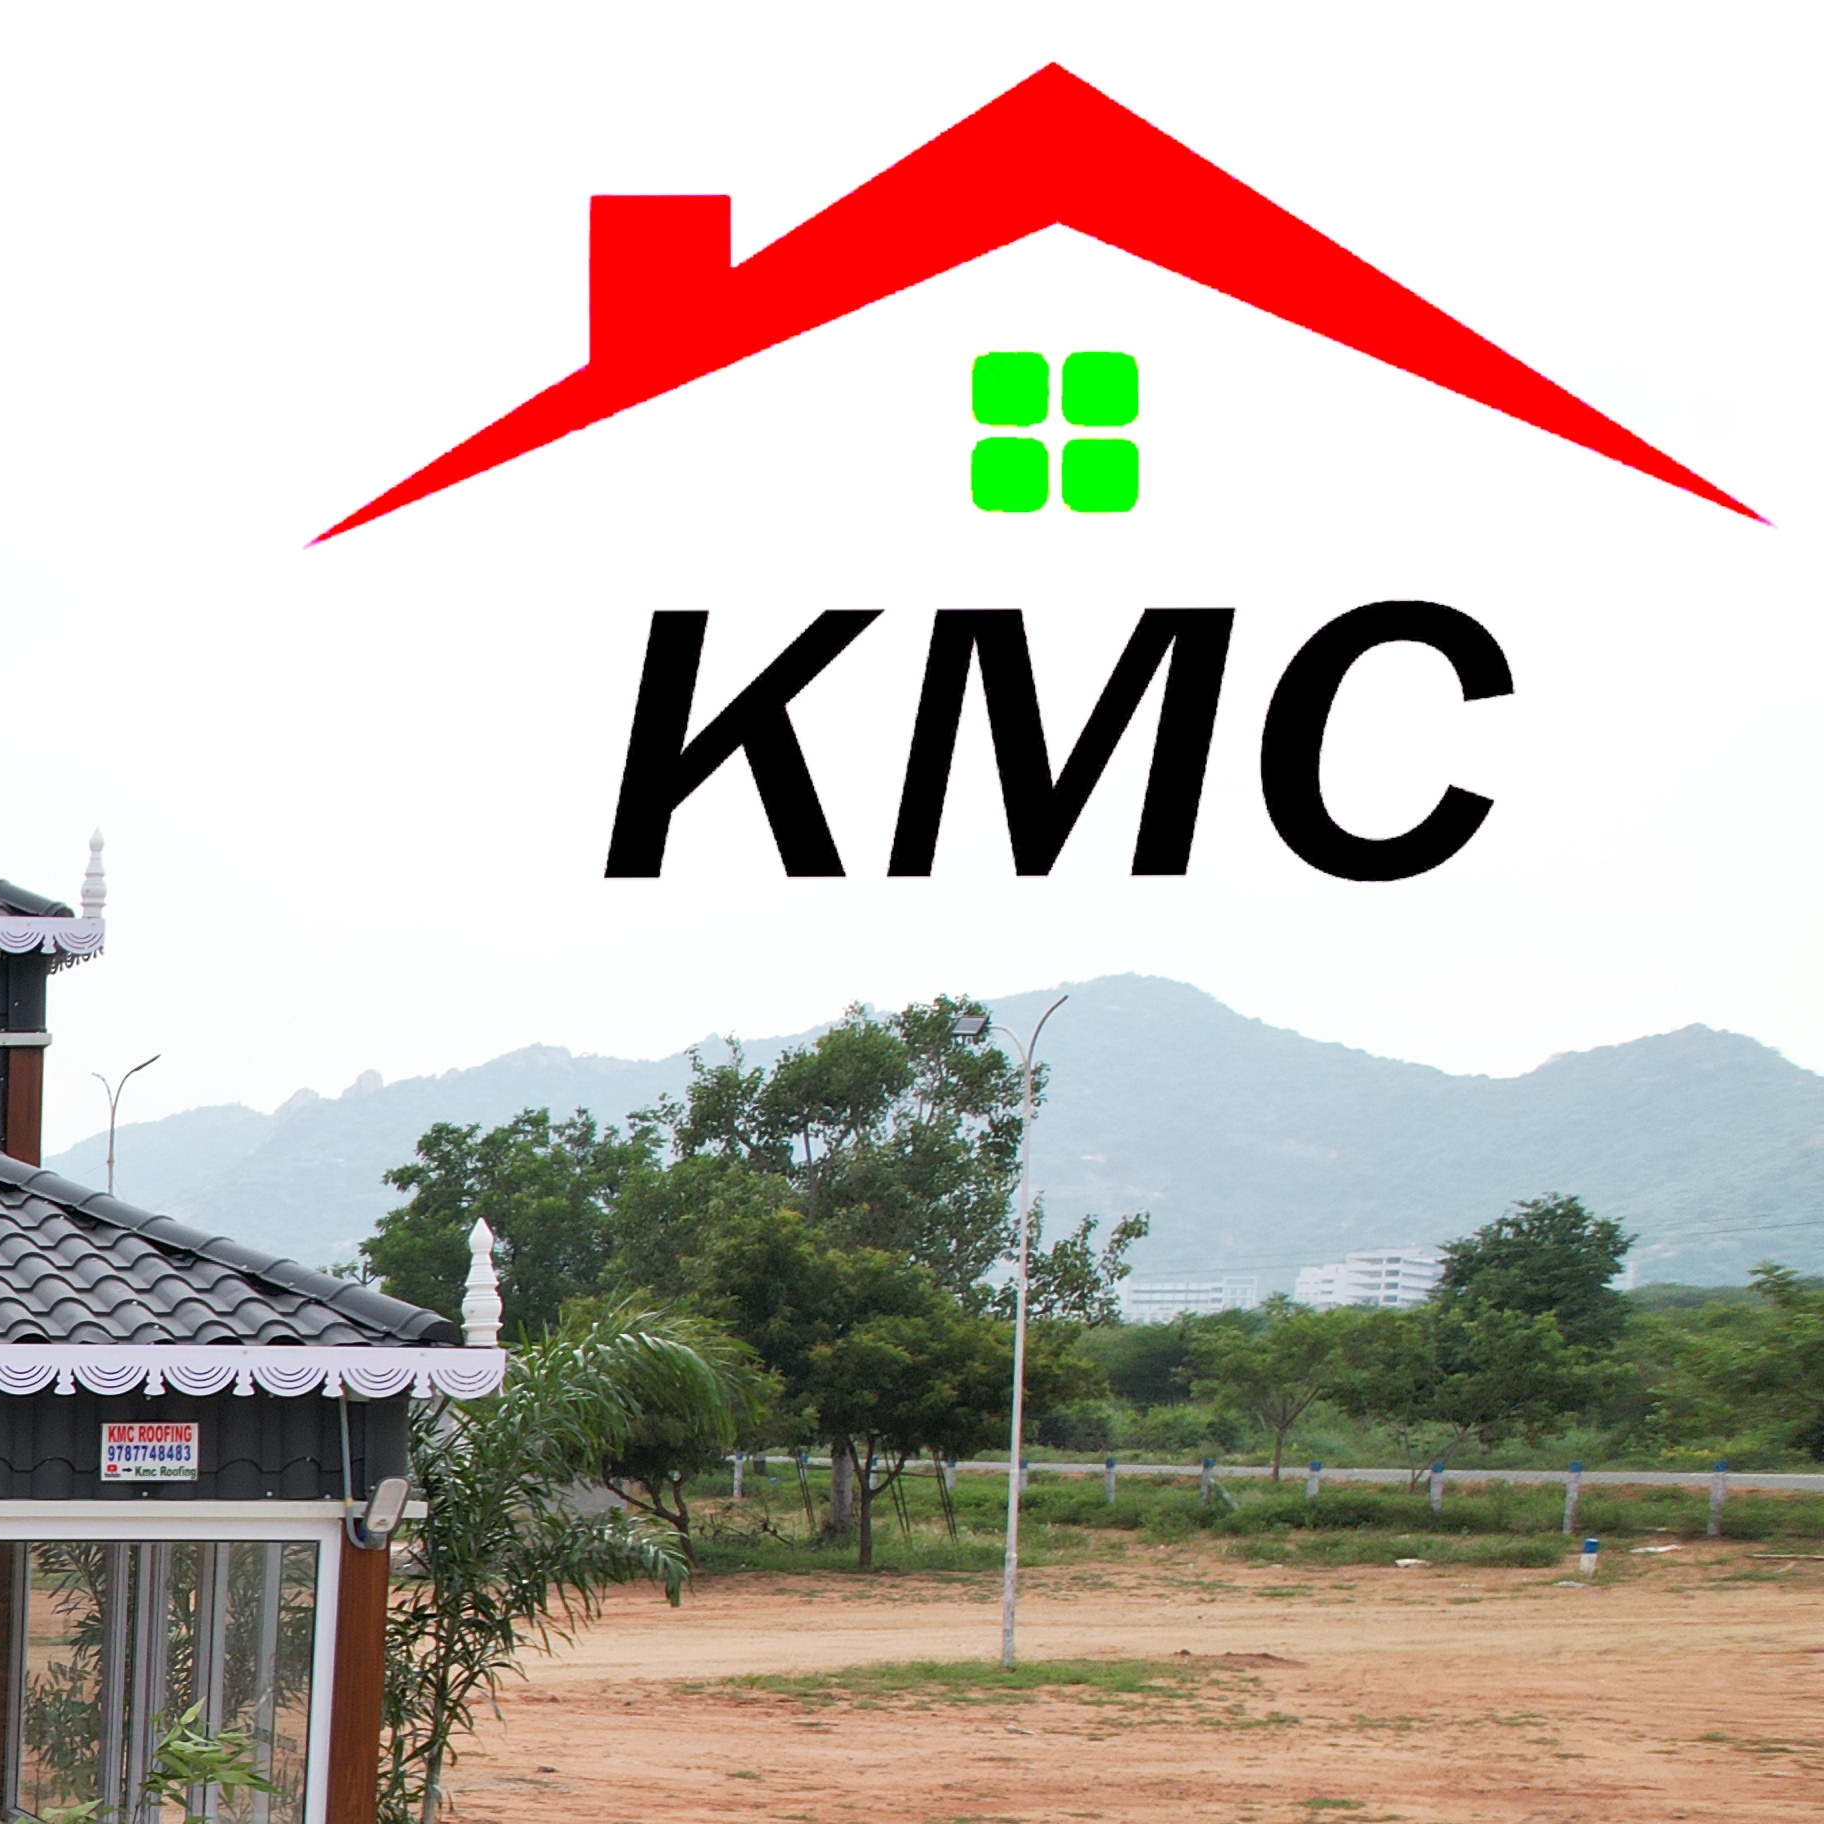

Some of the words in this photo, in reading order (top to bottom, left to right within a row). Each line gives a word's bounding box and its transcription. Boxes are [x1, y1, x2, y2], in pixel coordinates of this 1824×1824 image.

[108, 1425, 135, 1443] KMC
[138, 1425, 192, 1443] ROOFING
[107, 1445, 192, 1462] 9787748483
[135, 1466, 157, 1477] Kmc
[160, 1465, 197, 1480] Roofing
